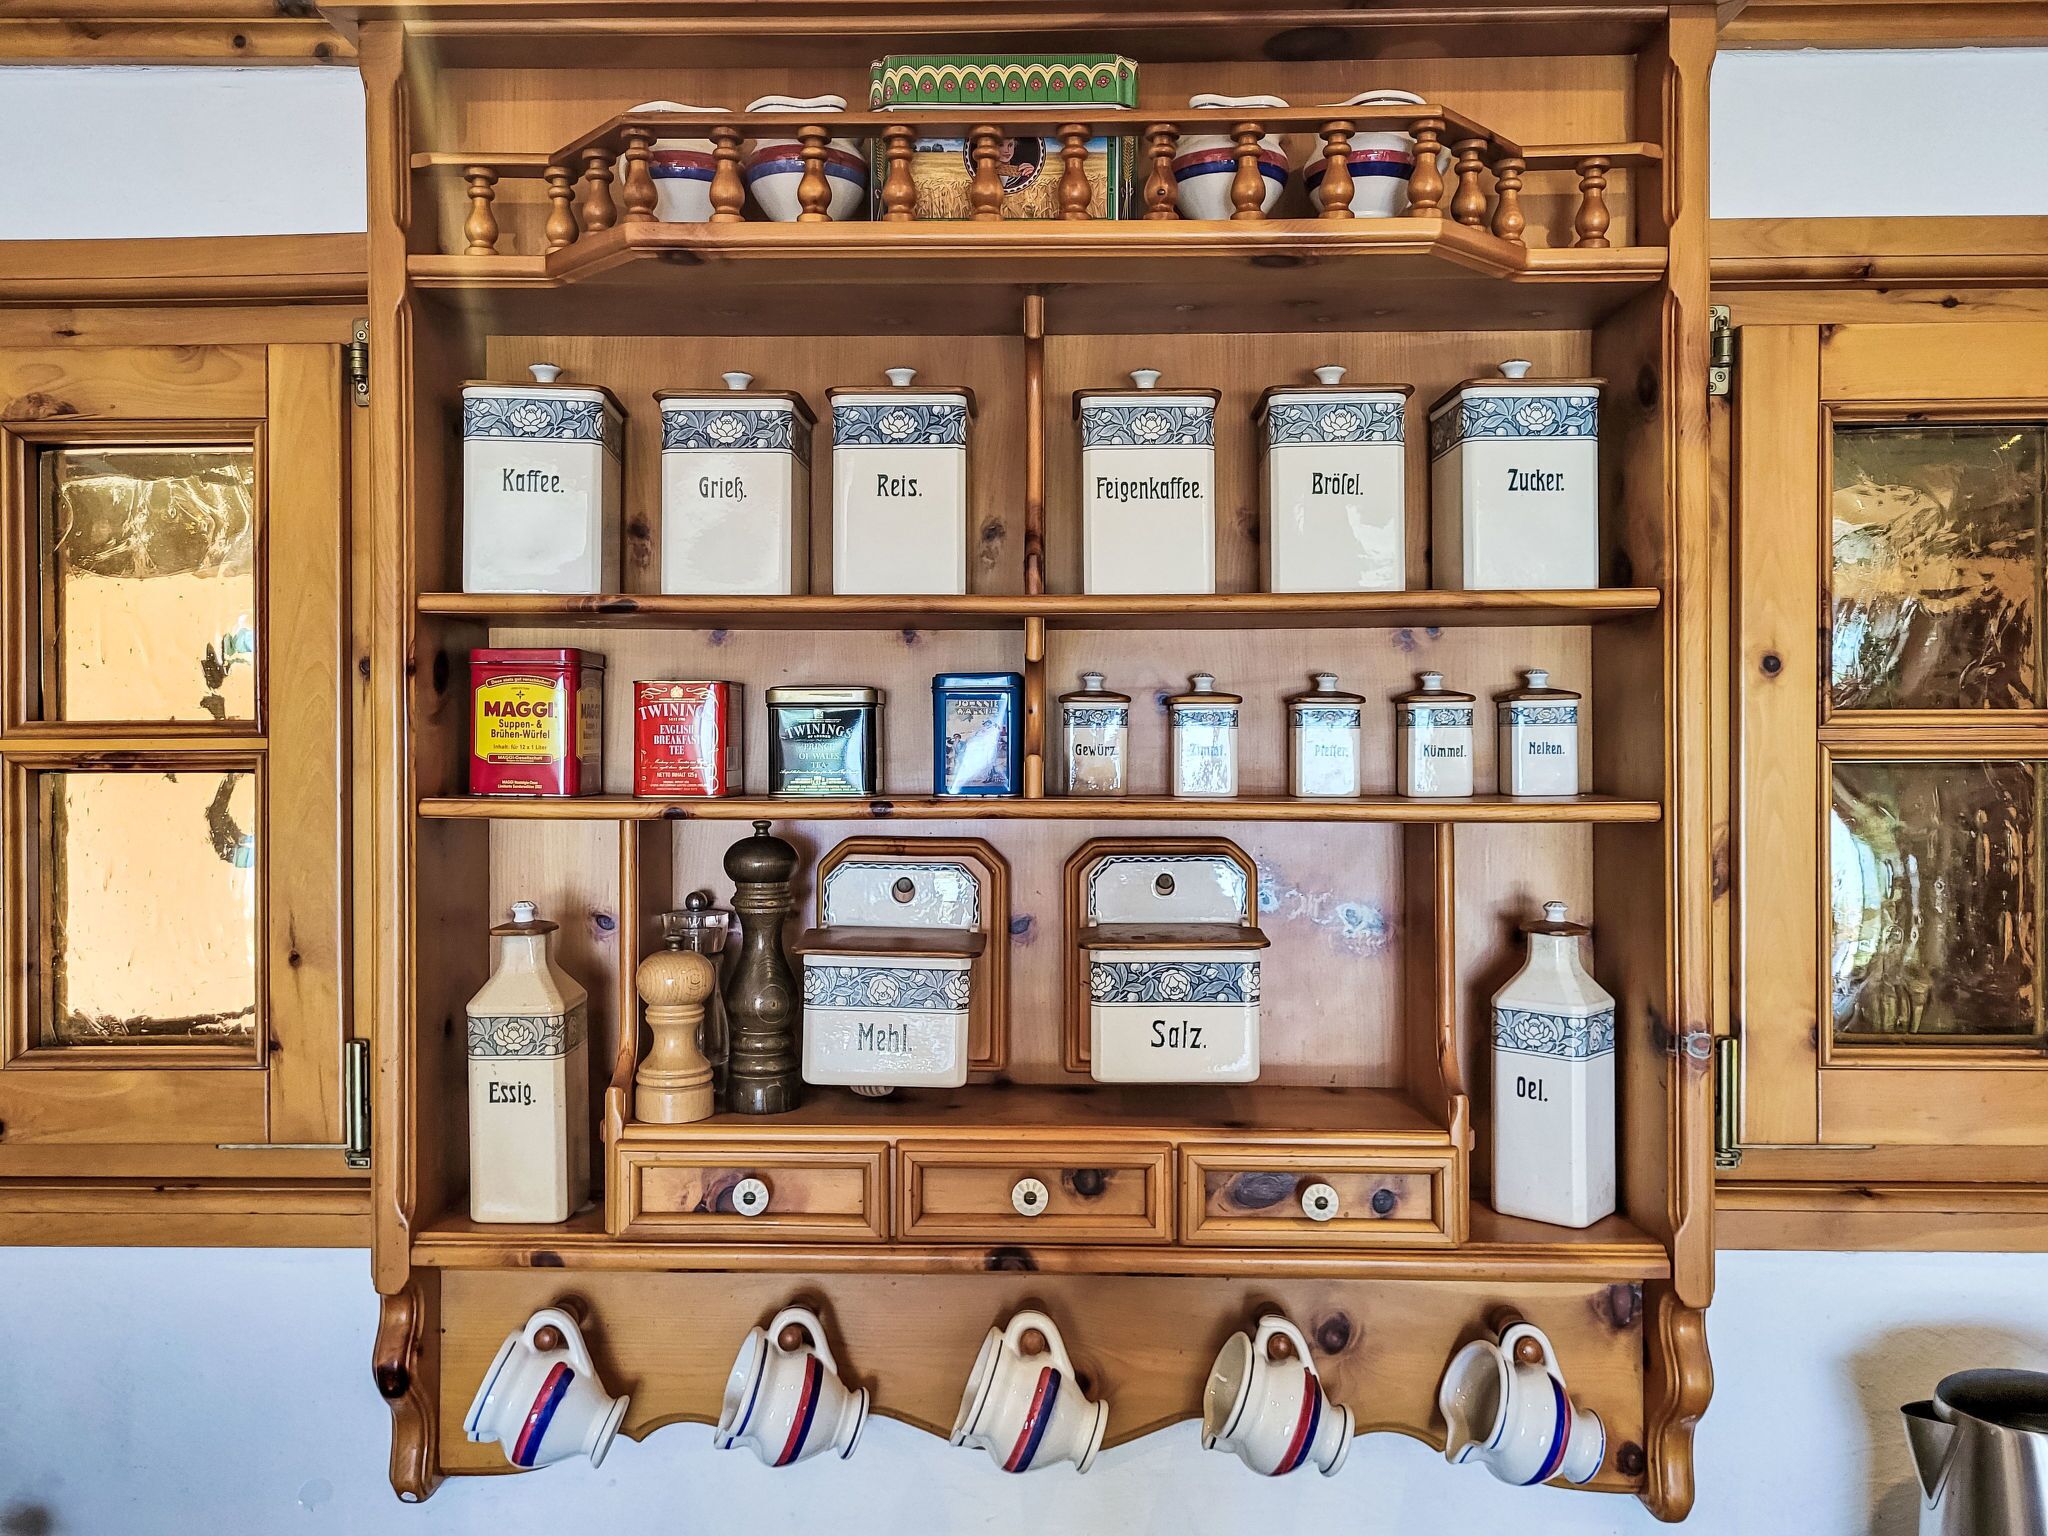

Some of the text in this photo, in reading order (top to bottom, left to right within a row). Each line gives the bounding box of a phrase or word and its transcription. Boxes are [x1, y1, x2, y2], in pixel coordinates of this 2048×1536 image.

[502, 468, 565, 493] Kaffee.
[877, 473, 923, 497] Reis.
[1507, 468, 1565, 492] Zucker.
[1096, 476, 1204, 503] Feigenkaffee.
[484, 701, 554, 718] MAGGI
[638, 703, 706, 721] TWINING
[498, 719, 543, 730] Suppen- &
[659, 724, 694, 735] ENGLISH
[784, 722, 854, 739] TWININGS
[490, 729, 550, 739] Brühen-Würfel
[669, 745, 685, 755] TEE
[1423, 744, 1467, 758] Kümmel.
[1528, 741, 1566, 755] Nelken.
[857, 1022, 913, 1053] Mehl.
[1150, 1019, 1208, 1050] Salz.
[488, 1081, 536, 1106] Essig.
[1516, 1076, 1548, 1103] Oel.
